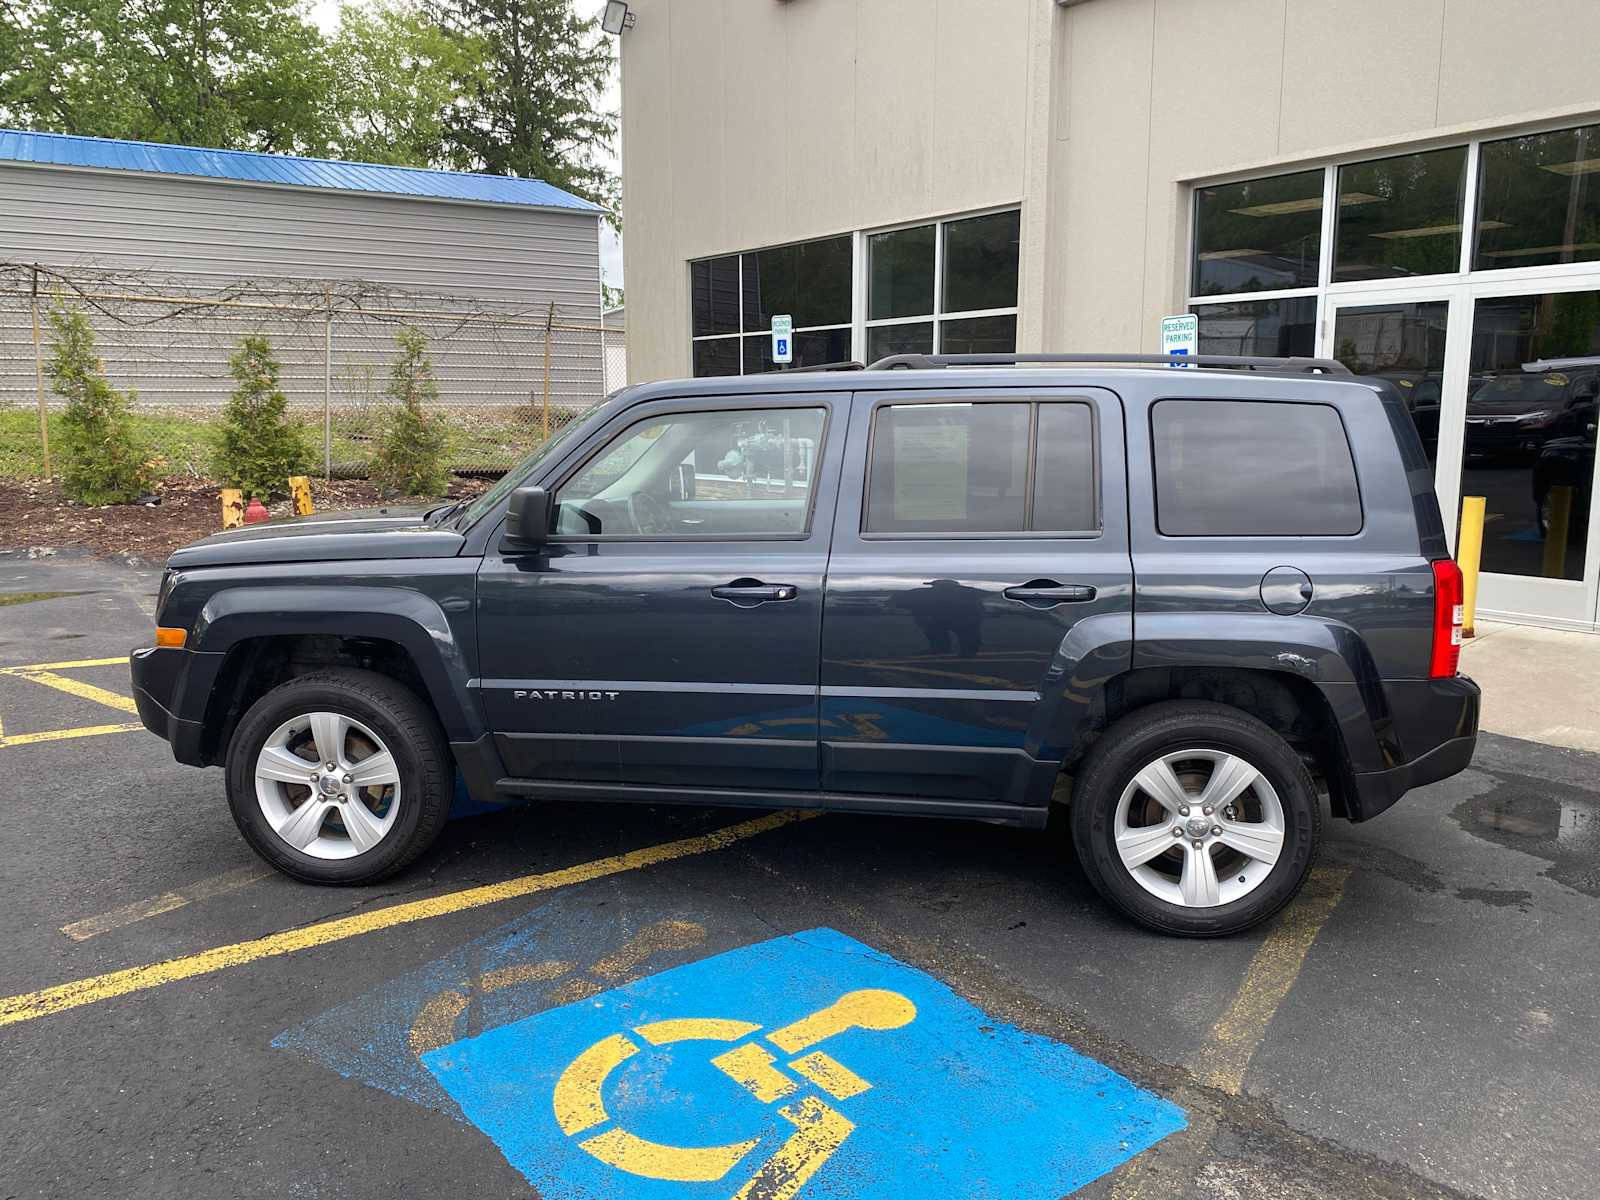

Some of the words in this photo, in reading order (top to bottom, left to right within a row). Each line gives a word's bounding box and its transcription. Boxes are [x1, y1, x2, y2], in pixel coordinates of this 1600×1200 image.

[1164, 321, 1195, 332] RESERVED
[1165, 332, 1193, 343] PARKING
[513, 690, 620, 701] PATRIOT
